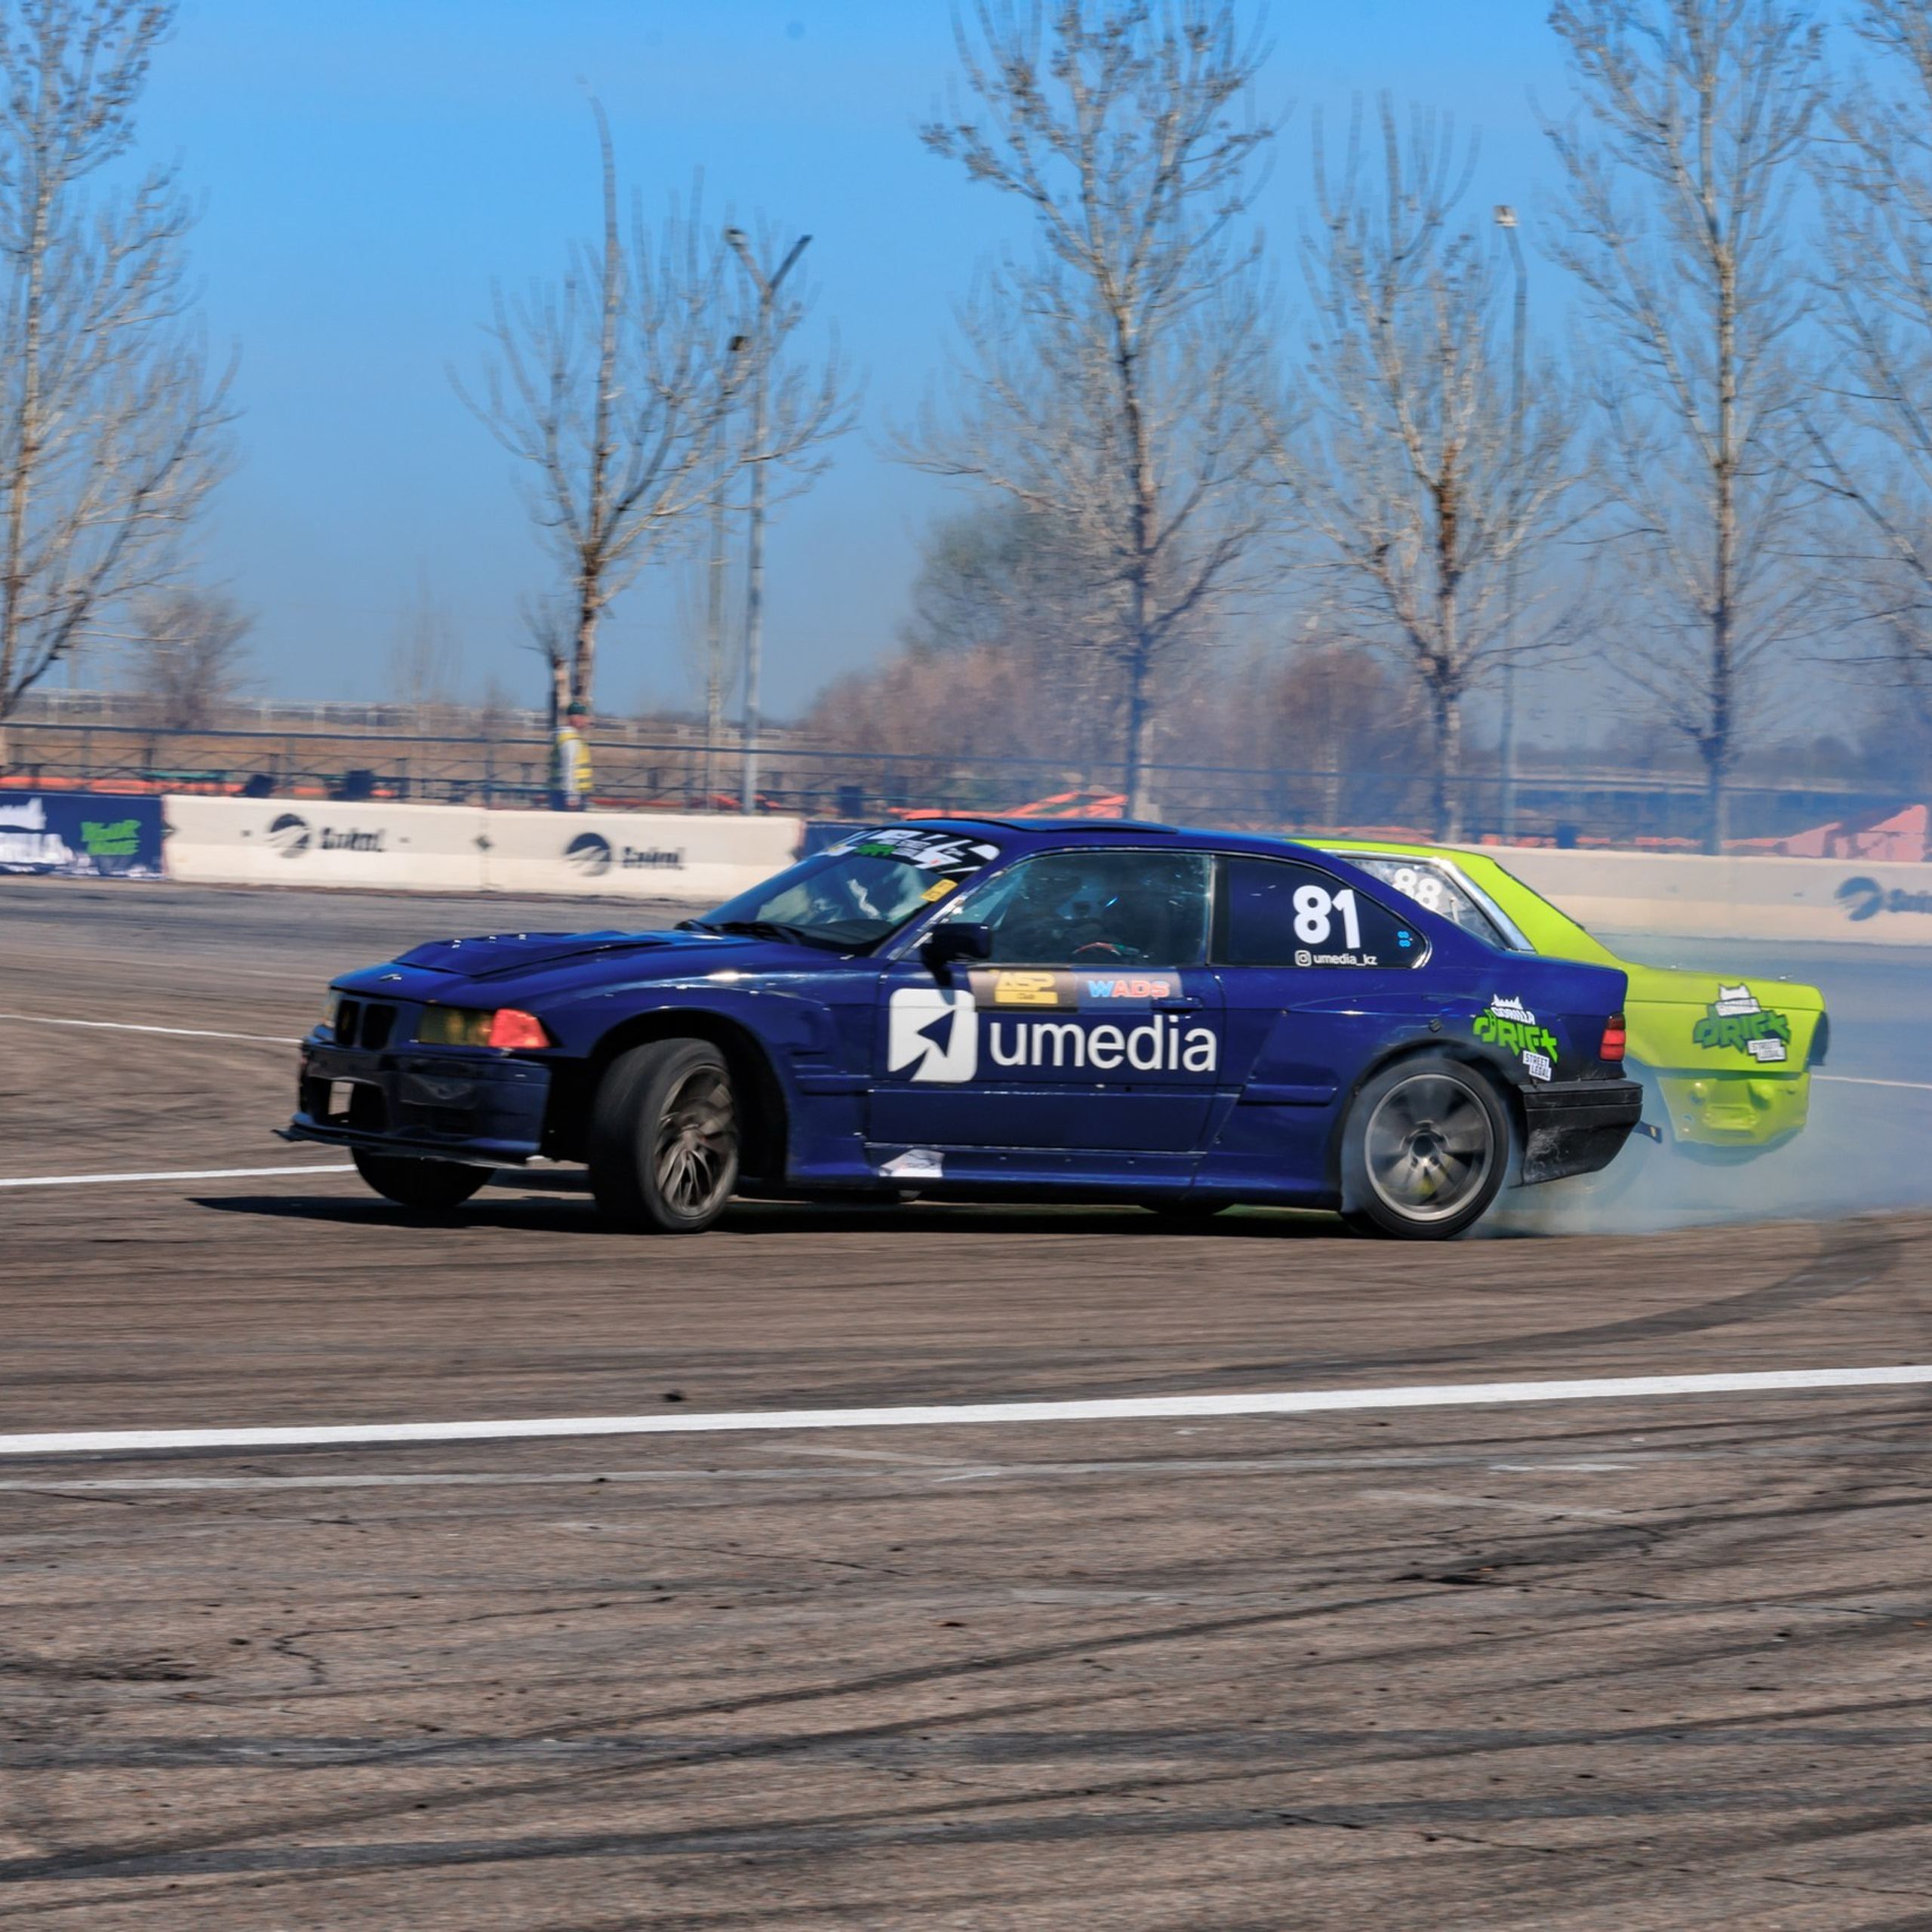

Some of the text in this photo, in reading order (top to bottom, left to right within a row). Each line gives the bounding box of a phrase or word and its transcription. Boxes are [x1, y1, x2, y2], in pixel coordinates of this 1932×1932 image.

[1392, 868, 1441, 911] 88
[1293, 885, 1361, 949] 81
[1313, 953, 1378, 966] umedia_kz
[1088, 980, 1171, 998] WADS
[990, 1014, 1217, 1072] umedia
